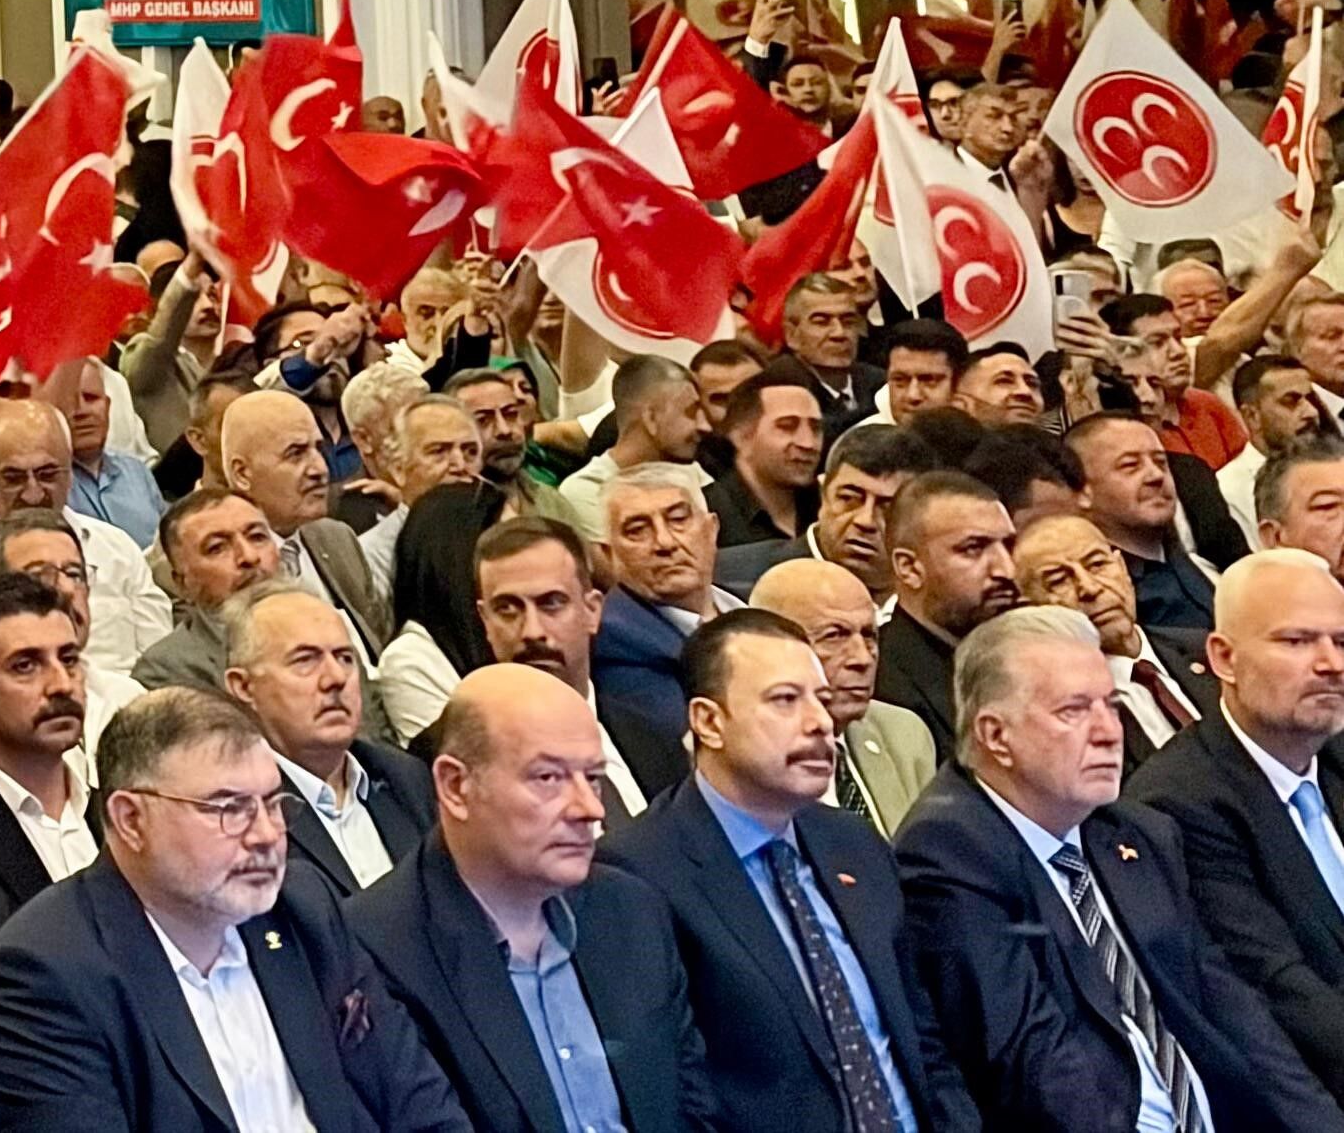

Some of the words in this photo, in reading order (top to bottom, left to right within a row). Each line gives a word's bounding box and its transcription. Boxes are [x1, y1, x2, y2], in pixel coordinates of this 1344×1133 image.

[110, 1, 141, 18] MHP
[144, 1, 189, 18] GENEL
[193, 0, 254, 18] BAŞKANI
